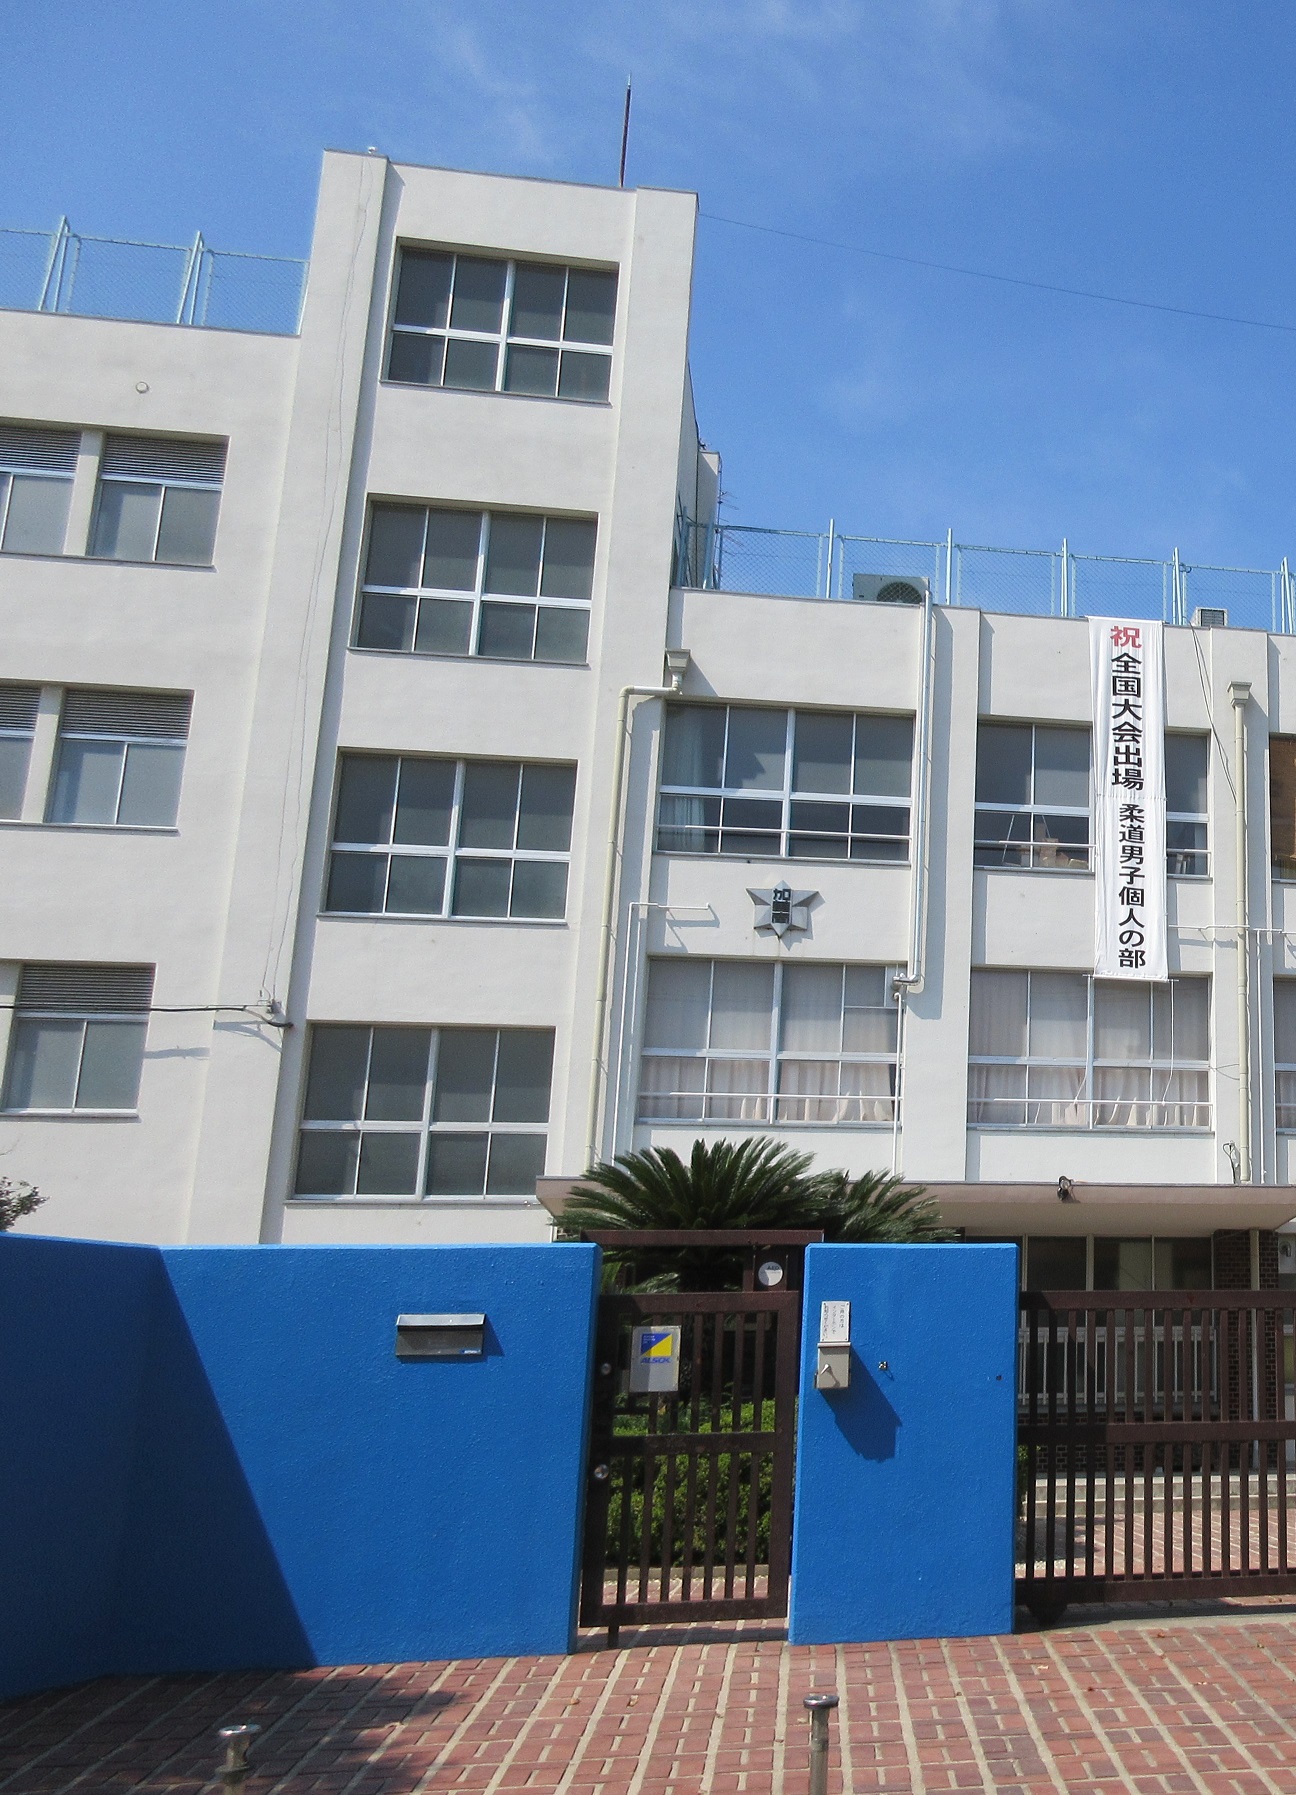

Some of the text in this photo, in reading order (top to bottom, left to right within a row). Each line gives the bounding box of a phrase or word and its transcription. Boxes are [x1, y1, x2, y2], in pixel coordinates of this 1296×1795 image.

[1110, 625, 1146, 969] 祝 全国大会出場 柔道男子個人の部
